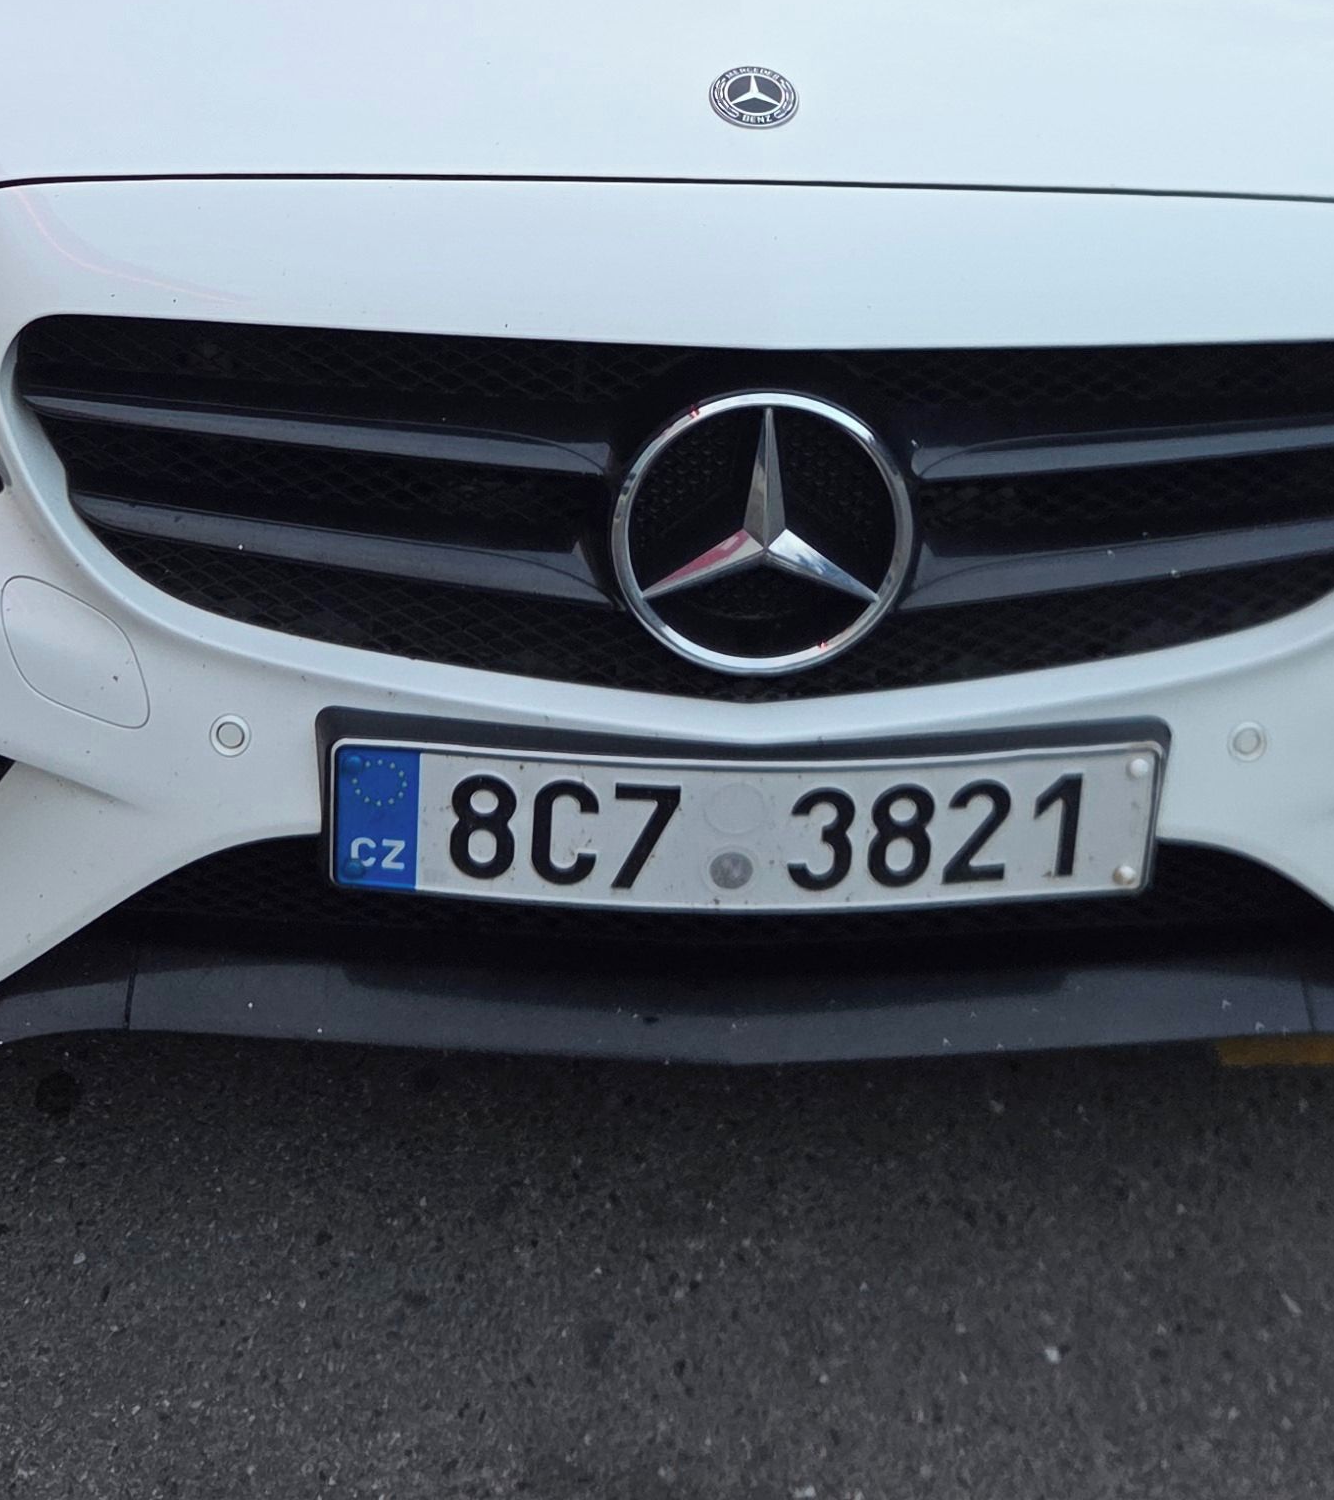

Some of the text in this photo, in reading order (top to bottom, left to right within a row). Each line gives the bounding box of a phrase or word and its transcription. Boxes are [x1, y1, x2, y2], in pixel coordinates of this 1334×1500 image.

[350, 837, 406, 870] CZ
[449, 772, 1084, 891] 8C7 3821
